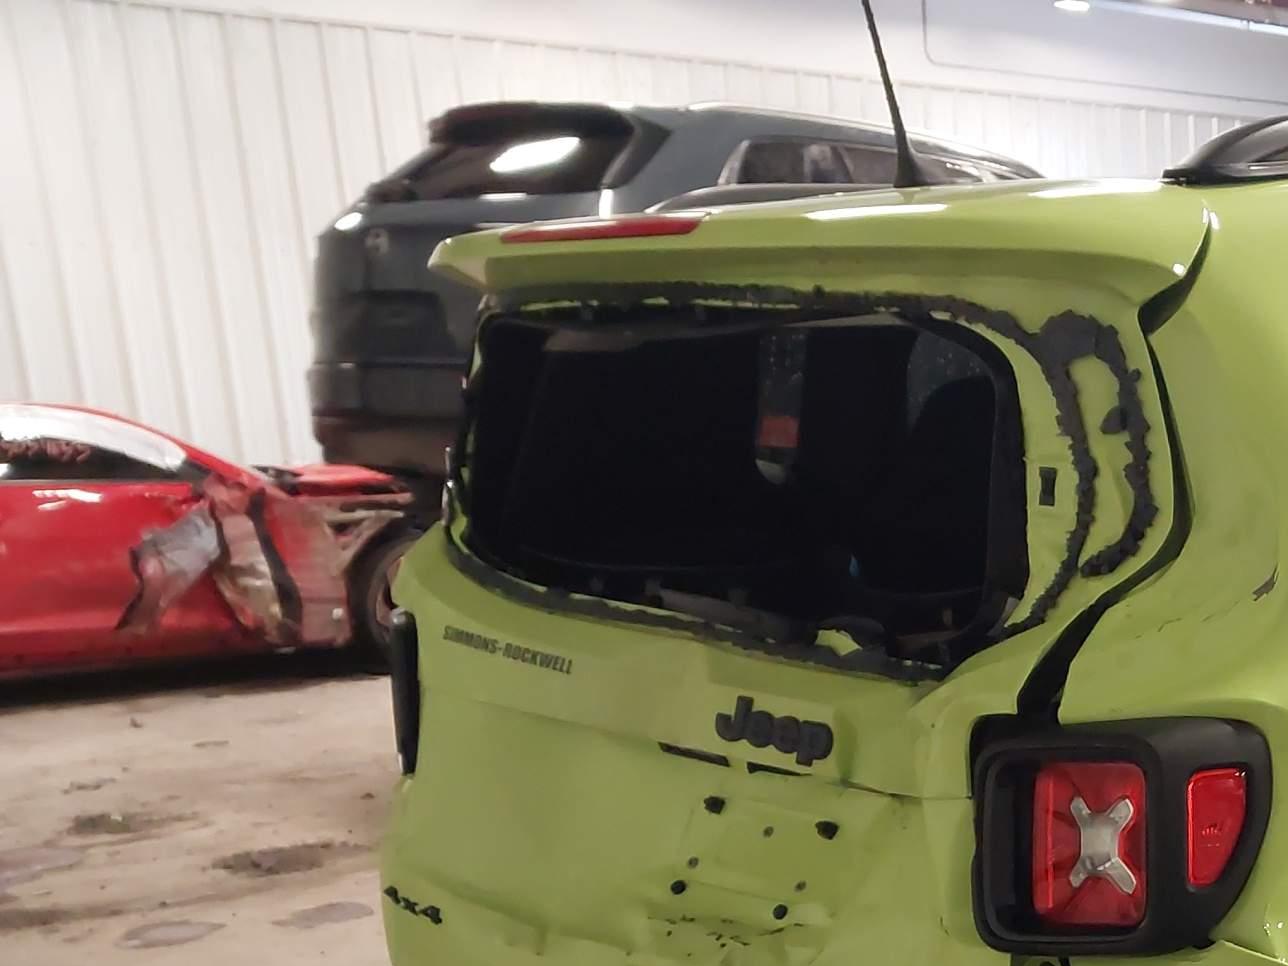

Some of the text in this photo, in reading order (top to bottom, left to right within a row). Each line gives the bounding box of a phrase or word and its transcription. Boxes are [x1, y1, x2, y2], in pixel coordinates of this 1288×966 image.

[443, 625, 573, 675] SIMMONS-ROCKWELL
[715, 695, 834, 767] Jeep
[383, 886, 443, 926] 4x4
